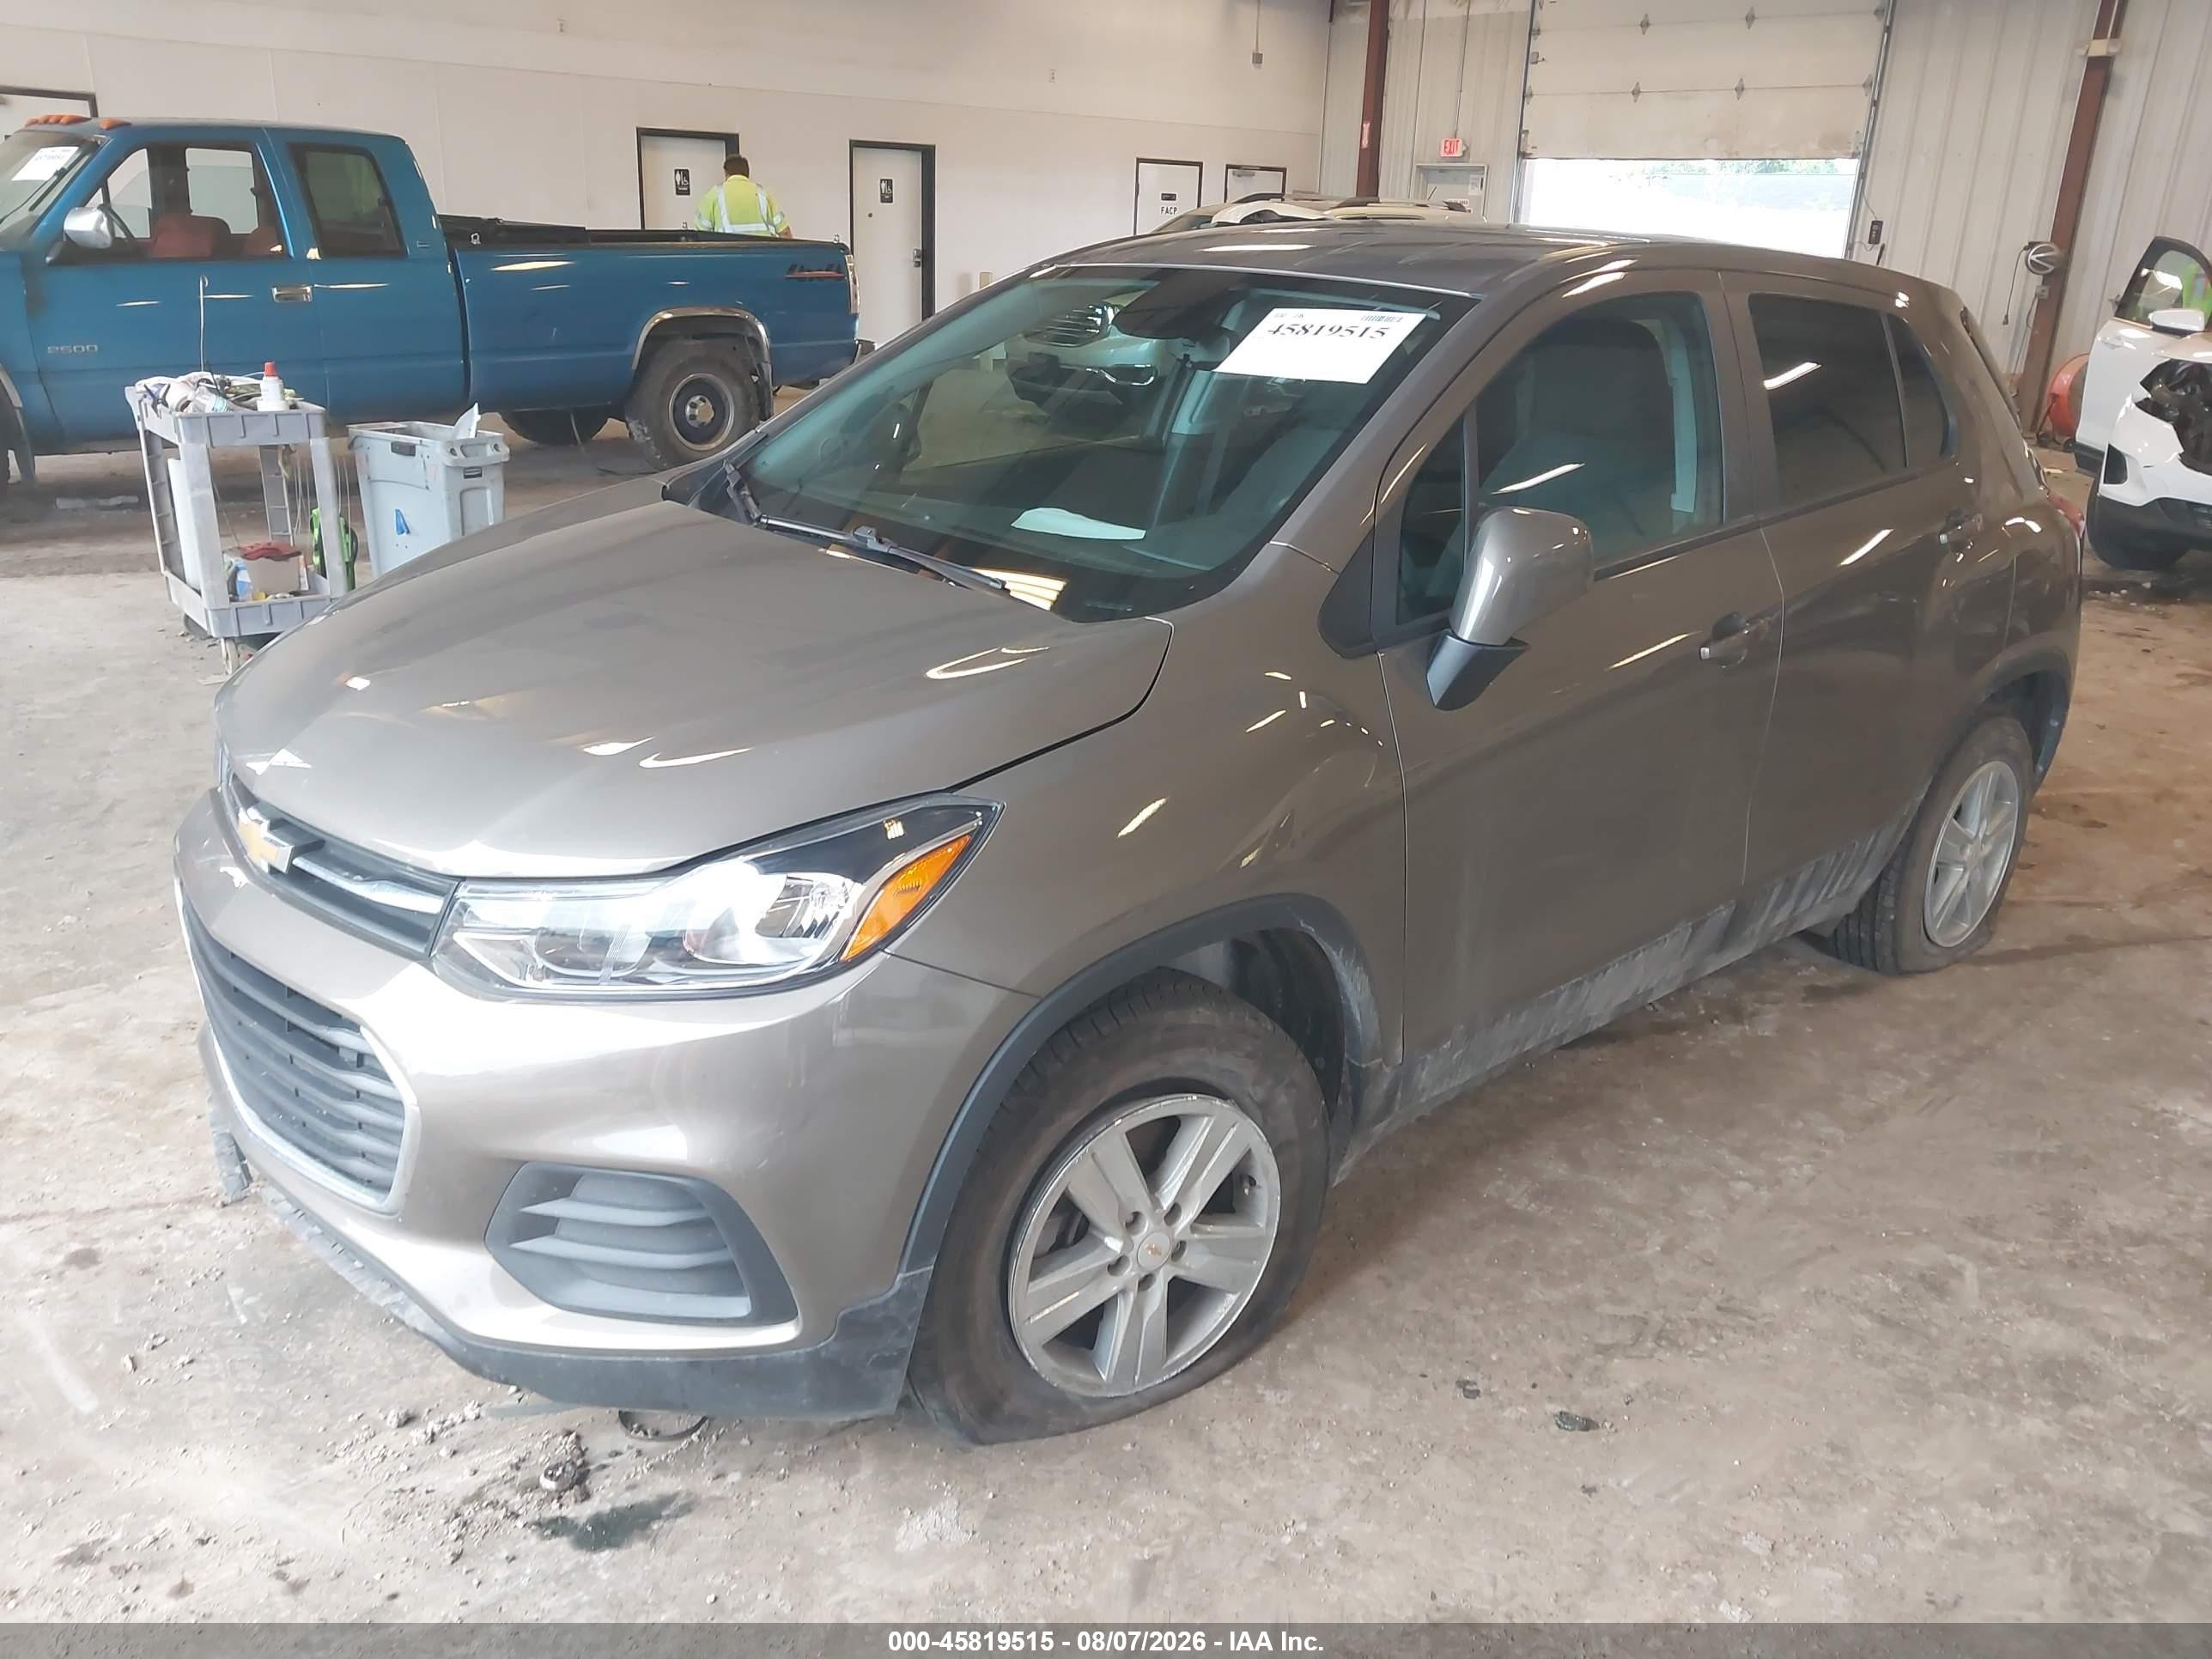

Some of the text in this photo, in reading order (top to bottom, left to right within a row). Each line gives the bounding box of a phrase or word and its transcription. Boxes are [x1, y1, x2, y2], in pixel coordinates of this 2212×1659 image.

[1443, 139, 1460, 155] EXIT
[1161, 206, 1177, 215] FACP
[1267, 324, 1390, 338] 45819515
[47, 344, 98, 355] 2500
